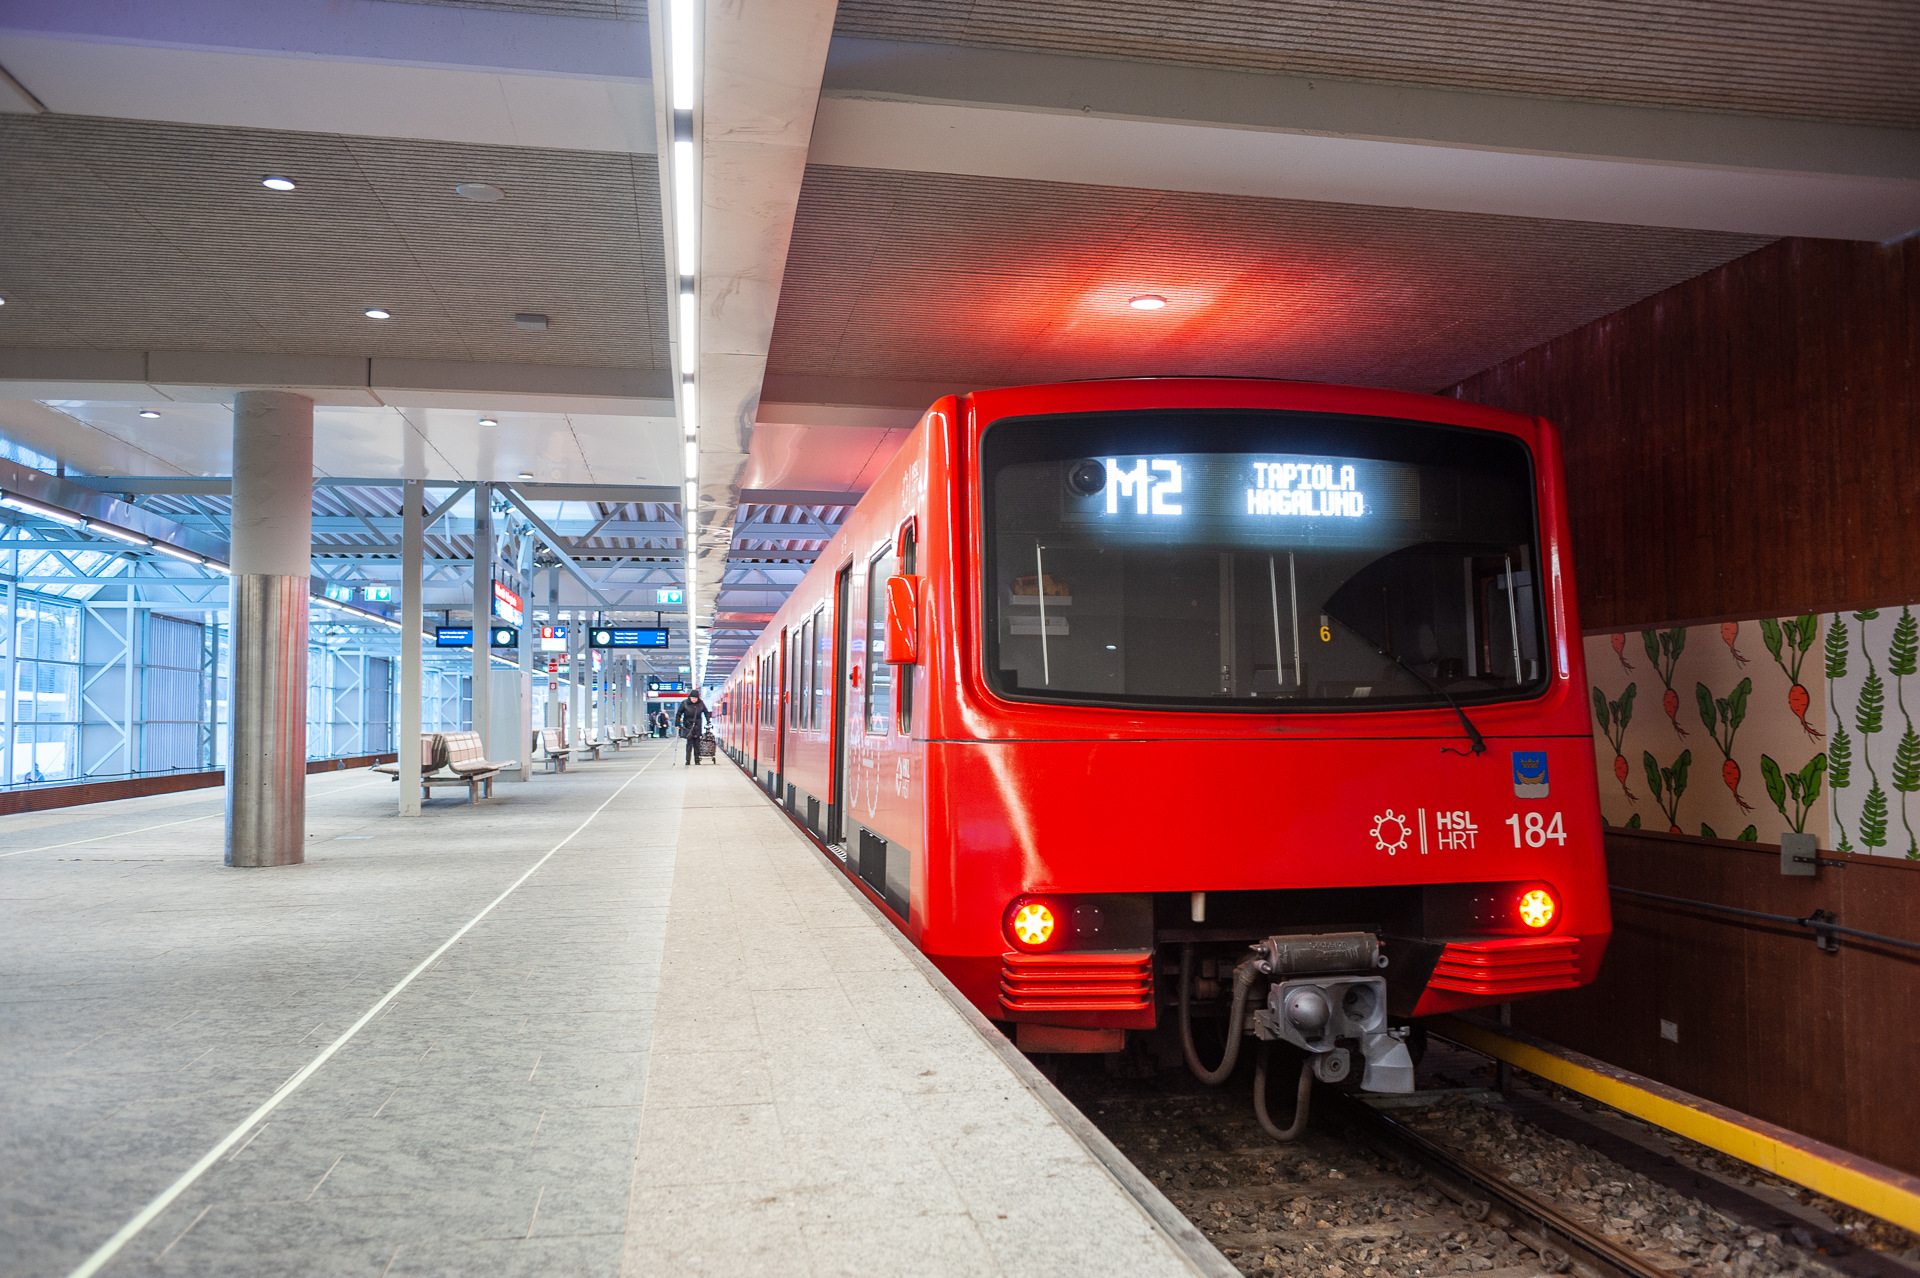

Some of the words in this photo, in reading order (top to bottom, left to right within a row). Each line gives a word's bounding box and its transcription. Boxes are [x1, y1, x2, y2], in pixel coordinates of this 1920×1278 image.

[1106, 458, 1182, 515] M2
[1253, 462, 1355, 490] TAPIOLA
[1246, 489, 1364, 516] HAGALUND
[1319, 625, 1332, 642] 6
[1436, 810, 1478, 830] HSL
[1505, 811, 1568, 849] 184
[1438, 830, 1479, 850] HRT
